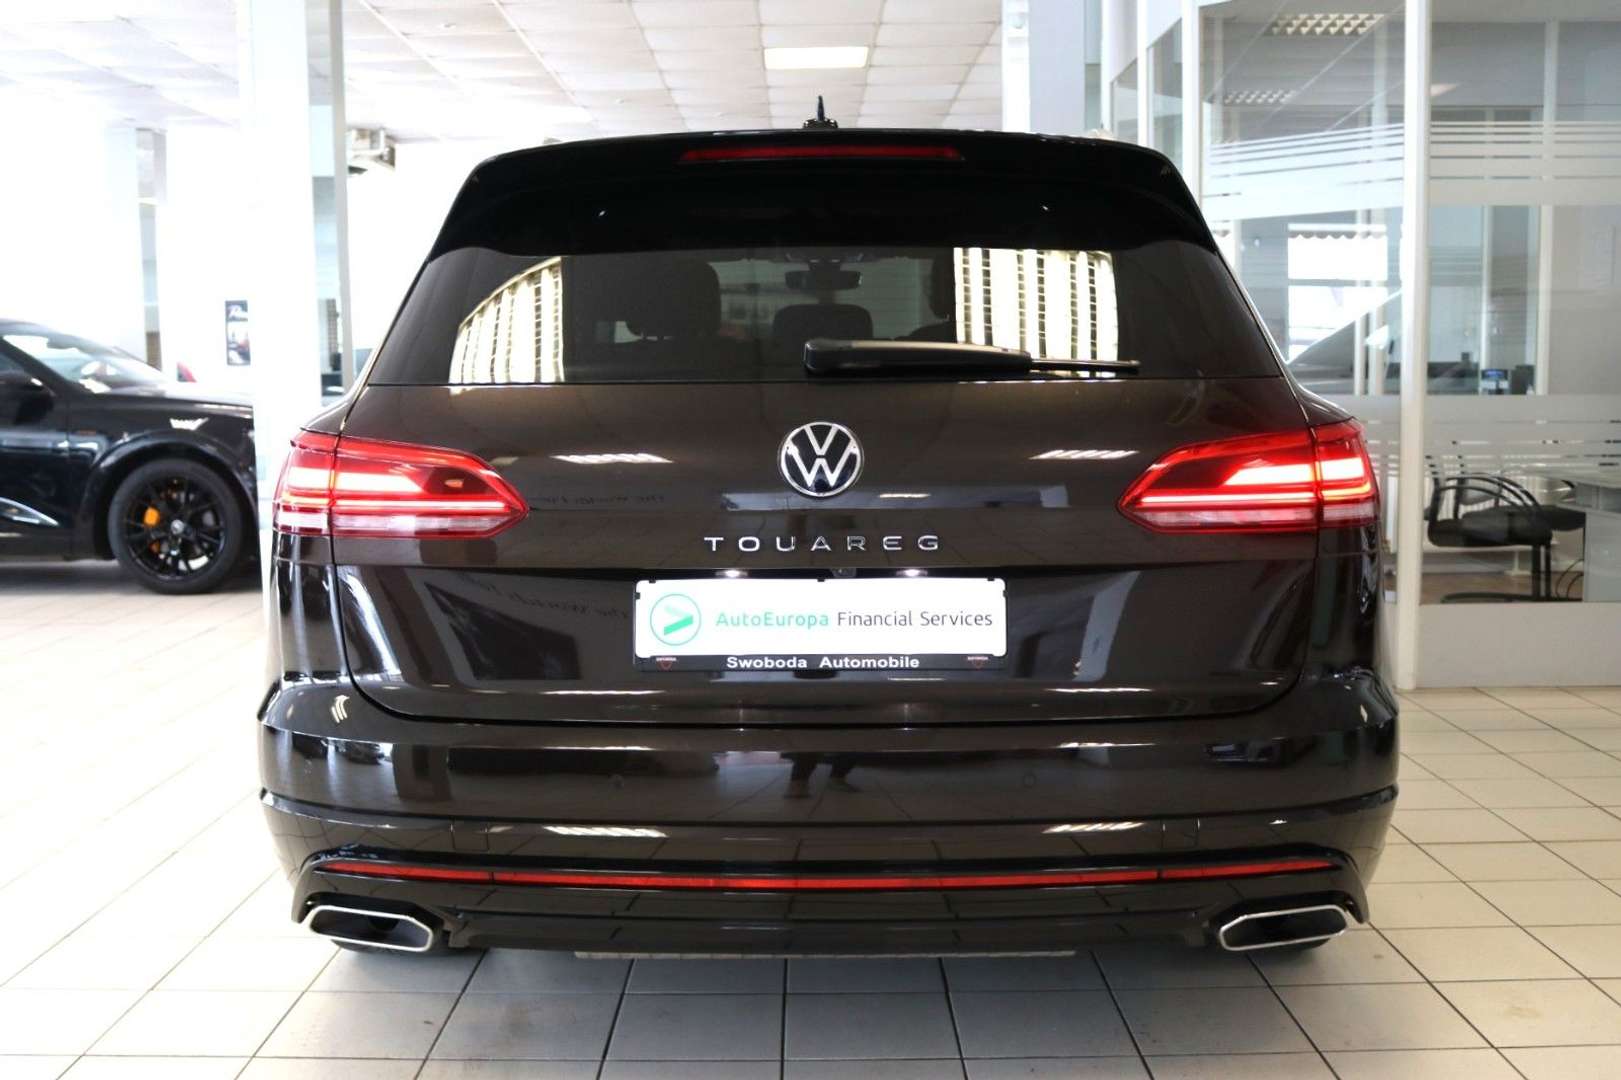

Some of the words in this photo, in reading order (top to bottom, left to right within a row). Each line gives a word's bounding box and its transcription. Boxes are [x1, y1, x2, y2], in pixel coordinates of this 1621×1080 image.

[704, 535, 940, 552] TOUAREG
[715, 611, 829, 630] AutoEuropa
[837, 611, 913, 627] Financial
[920, 611, 993, 627] Services
[726, 656, 808, 669] Swoboda
[818, 656, 920, 669] Automobile
